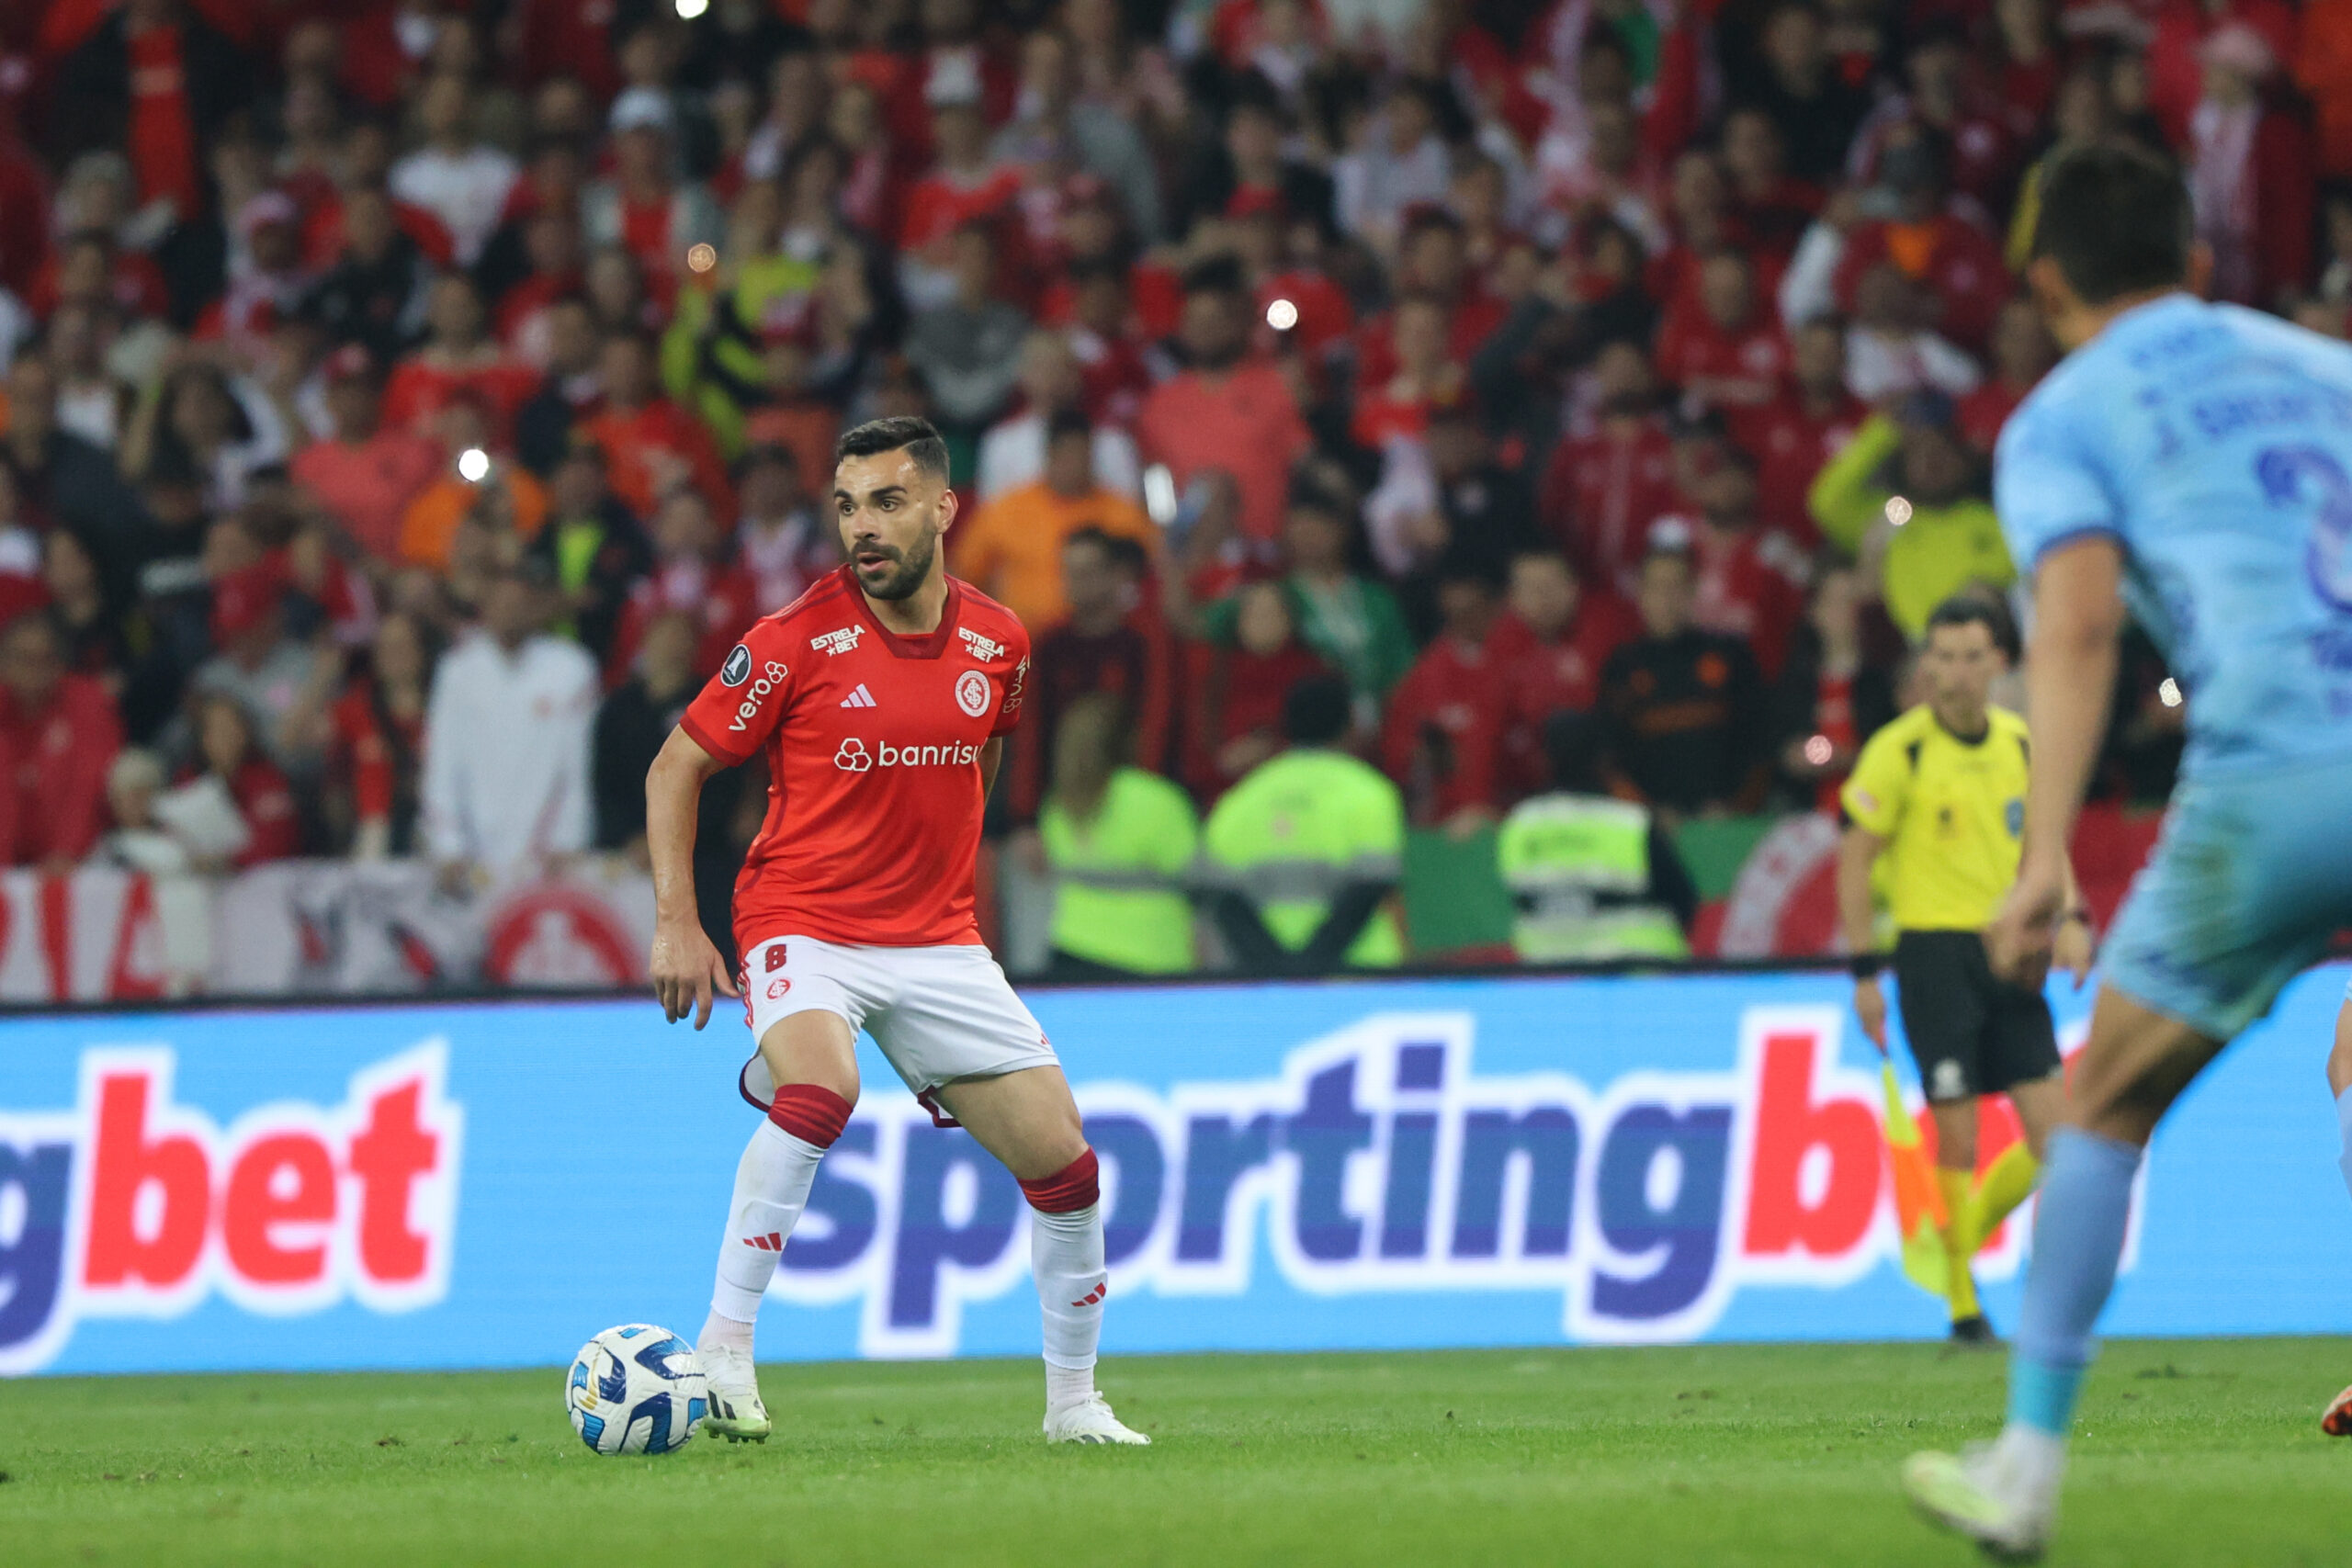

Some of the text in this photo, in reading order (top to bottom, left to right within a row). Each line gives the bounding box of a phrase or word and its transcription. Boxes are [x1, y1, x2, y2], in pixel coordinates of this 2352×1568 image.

[810, 625, 865, 650] ESTRELA
[834, 636, 858, 654] BET
[958, 626, 1004, 657] ESTRELA
[972, 646, 994, 663] BET
[729, 679, 772, 731] vero
[765, 944, 786, 973] 8
[779, 1029, 2133, 1332] sportingb
